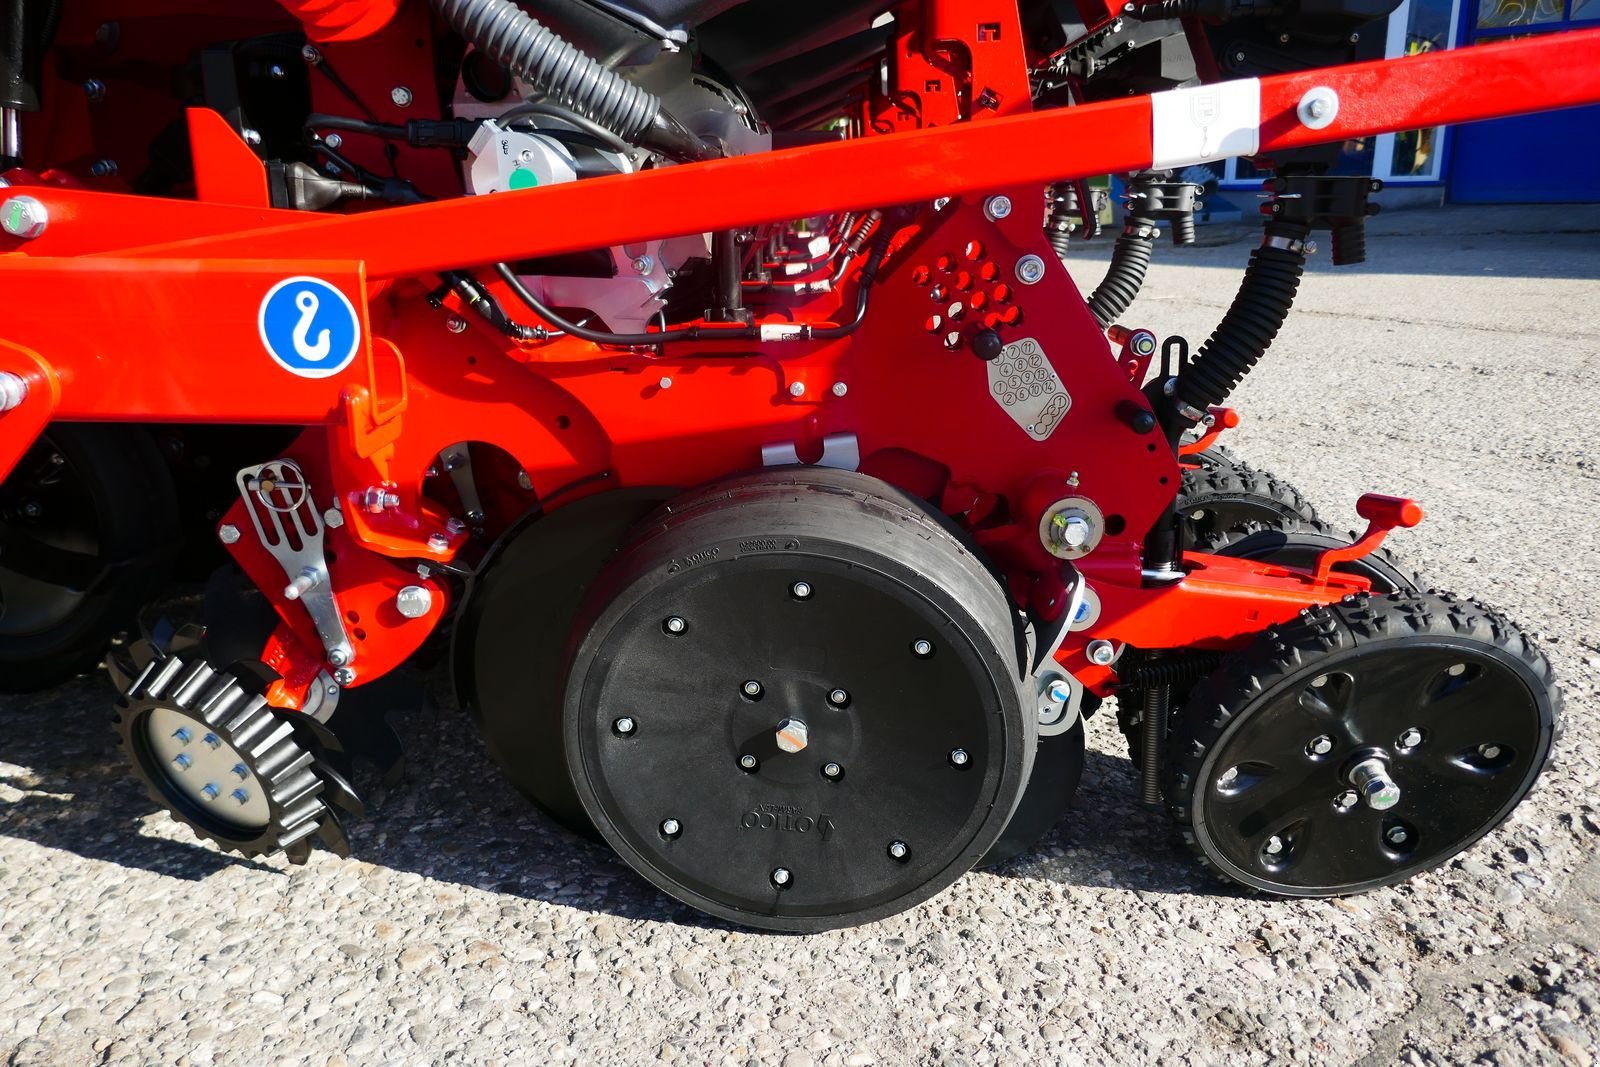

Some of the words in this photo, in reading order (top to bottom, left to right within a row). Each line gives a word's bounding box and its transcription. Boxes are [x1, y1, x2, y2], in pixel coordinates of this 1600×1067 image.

[1024, 343, 1032, 352] 11
[1031, 356, 1039, 366] 12
[1037, 370, 1045, 379] 13
[1032, 385, 1039, 394] 10
[1045, 382, 1053, 392] 14
[741, 811, 814, 834] OTICO
